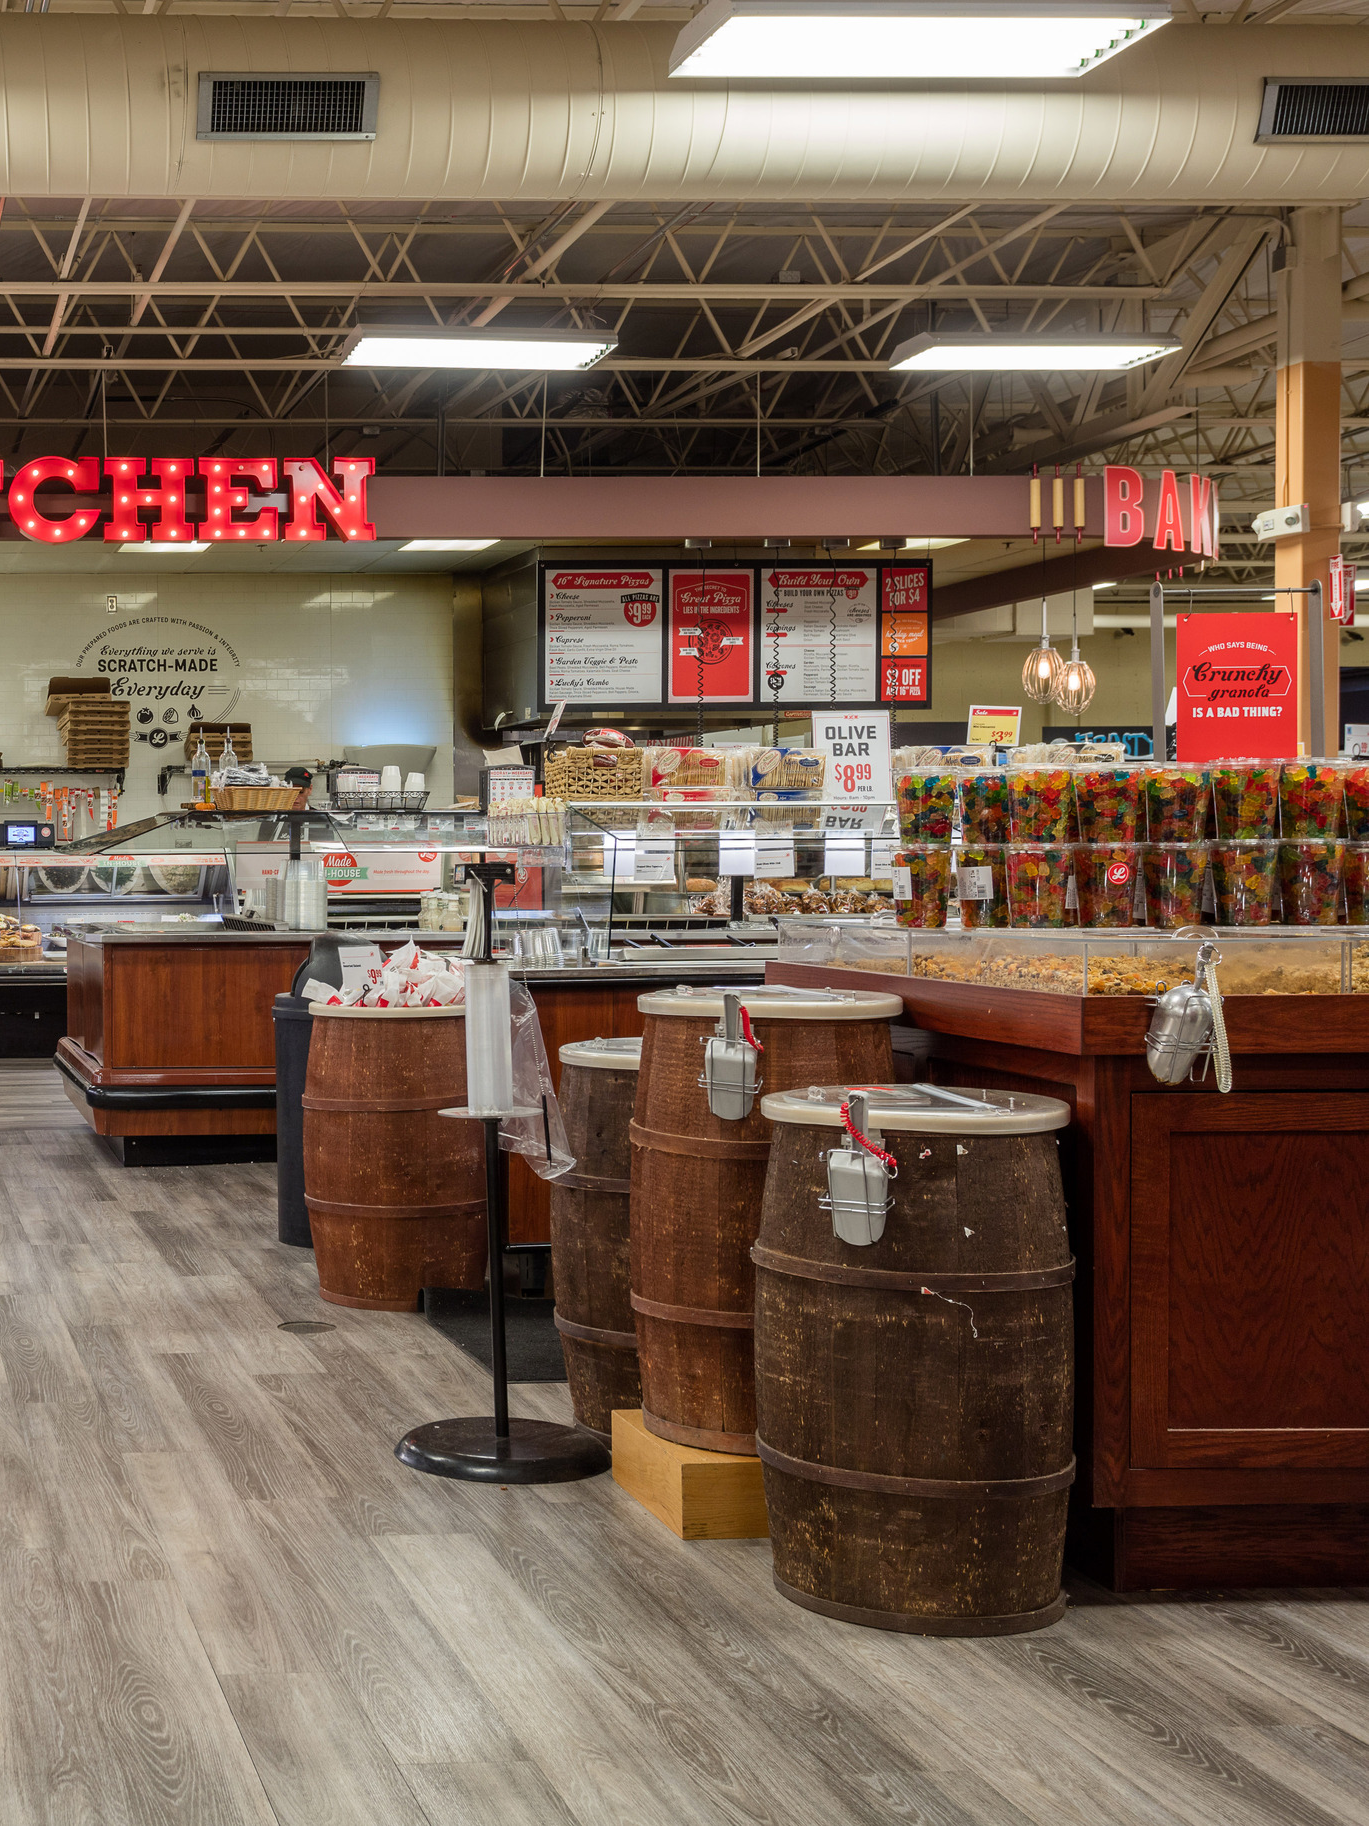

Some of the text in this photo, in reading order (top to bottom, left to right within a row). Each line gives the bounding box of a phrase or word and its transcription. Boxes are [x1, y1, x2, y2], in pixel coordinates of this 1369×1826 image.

[1104, 465, 1219, 561] BAK
[574, 576, 618, 586] Signature
[621, 575, 649, 586] Pizzas
[779, 574, 860, 585] Build Your Own
[886, 573, 924, 592] 2 SLICES
[556, 592, 579, 600] Cheese
[681, 592, 741, 605] Great Pizza
[890, 589, 920, 606] FOR $4
[683, 606, 693, 614] LIES
[700, 606, 709, 614] THE
[710, 606, 740, 614] INGREDIENTS
[555, 613, 591, 623] Pepperoni
[76, 654, 85, 668] OUR
[83, 631, 107, 655] PREPARED
[107, 621, 127, 634] FOODS
[128, 618, 140, 626] ARE
[170, 618, 187, 626] WITH
[188, 620, 214, 636] PASSION
[218, 637, 241, 667] INTEGRITY
[555, 635, 584, 644] Caprese
[100, 645, 216, 657] Everything we serve is
[1208, 643, 1225, 652] WHO
[1246, 642, 1268, 652] BEING
[98, 658, 218, 672] SCRATCH-MADE
[556, 657, 581, 665] Garden
[584, 656, 607, 666] Veggie
[619, 656, 638, 664] Pesto
[902, 669, 921, 685] OFF
[1193, 662, 1283, 685] Crunchy
[111, 676, 205, 700] Everyday
[555, 678, 609, 687] Lucky's Combo
[909, 686, 921, 695] PIZZA
[1208, 684, 1269, 701] granola
[1192, 707, 1282, 718] IS A BAD THING?
[825, 726, 876, 740] OLIVE
[832, 743, 870, 756] BAR
[326, 856, 351, 866] Made
[325, 869, 360, 878] -HOUSE
